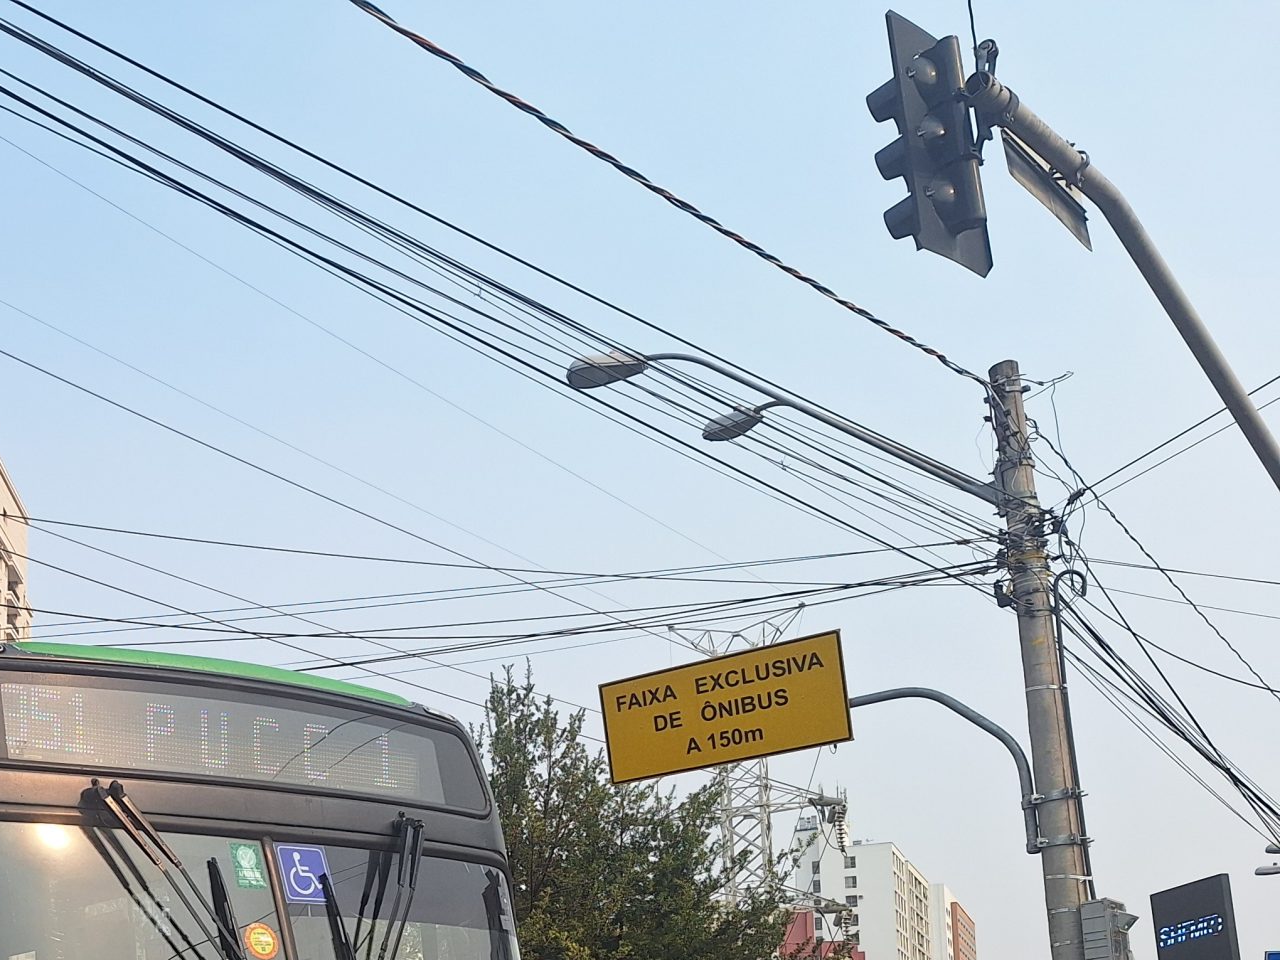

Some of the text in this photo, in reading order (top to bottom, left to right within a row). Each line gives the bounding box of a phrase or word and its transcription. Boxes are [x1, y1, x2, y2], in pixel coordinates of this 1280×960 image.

[616, 651, 824, 712] FAIXA EXCLUSIVA
[653, 688, 789, 732] DE ÔNIBUS
[686, 727, 764, 754] A 150m
